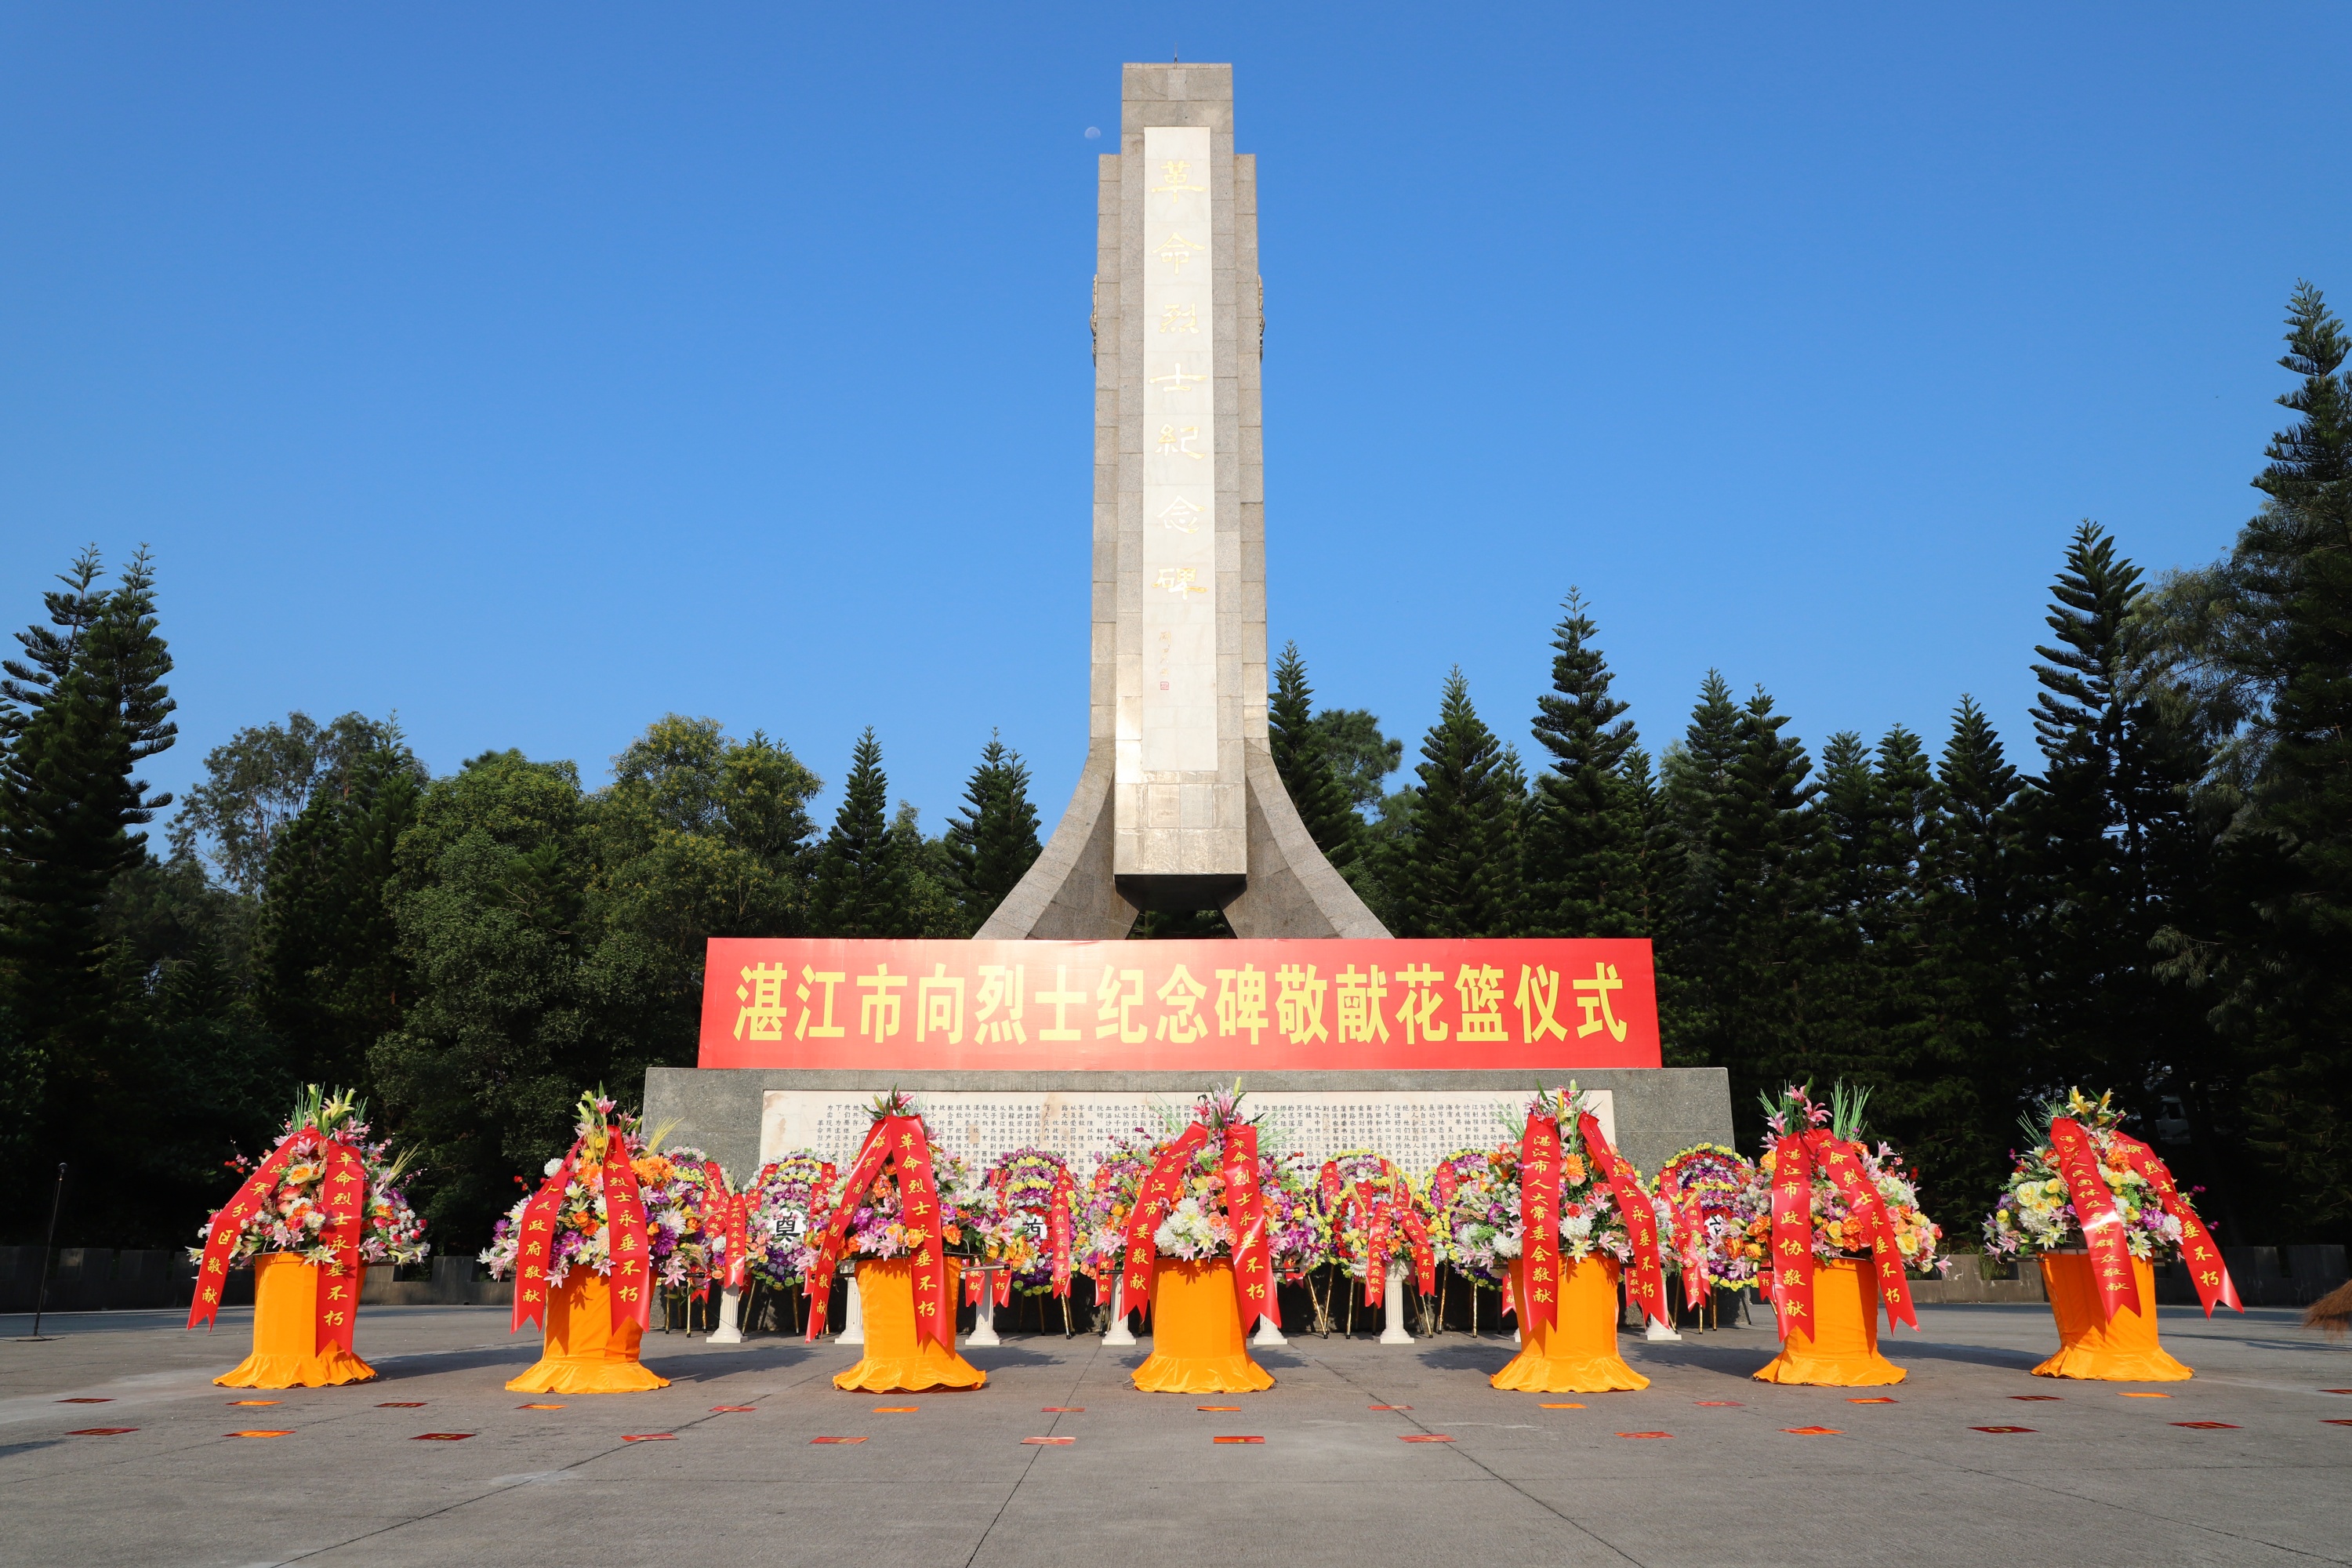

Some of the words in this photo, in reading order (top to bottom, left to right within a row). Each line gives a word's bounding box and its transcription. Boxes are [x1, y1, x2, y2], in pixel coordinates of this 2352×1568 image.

[733, 962, 1628, 1044] 湛江市向烈士纪念碑敬献花篮仪式
[201, 1149, 295, 1305] 江军分区敬献
[323, 1152, 357, 1327] 革命烈士永垂不朽
[898, 1134, 938, 1317] 革命烈士永垂不朽
[1054, 1192, 1067, 1286] 革命烈士永垂不朽
[1230, 1138, 1266, 1301] 革命烈士永垂不朽
[1528, 1134, 1554, 1303] 湛江市人大常委会敬献
[1778, 1149, 1808, 1317] 湛江市政协敬献
[2114, 1136, 2220, 1287] 命烈士永垂不朽
